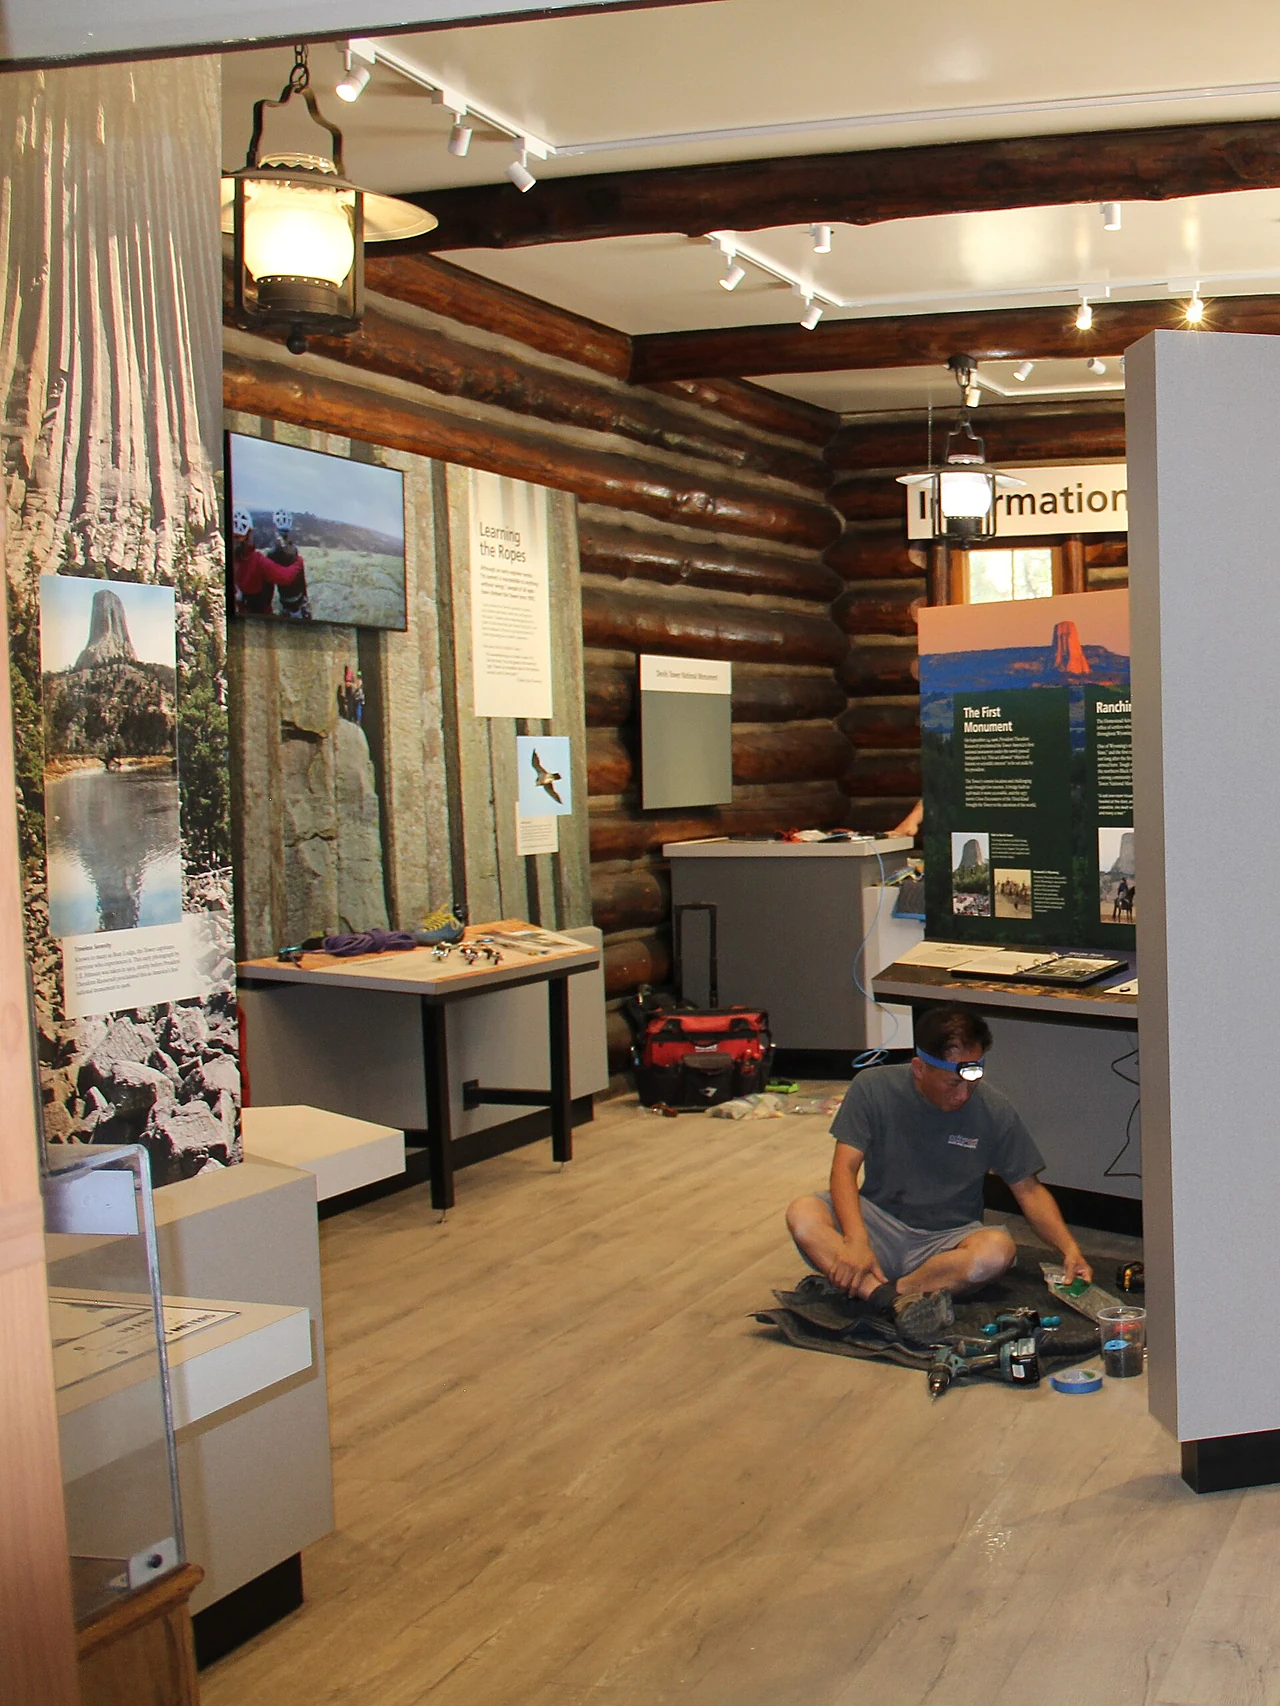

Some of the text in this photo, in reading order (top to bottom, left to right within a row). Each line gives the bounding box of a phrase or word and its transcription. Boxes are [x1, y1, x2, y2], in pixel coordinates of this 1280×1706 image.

[920, 482, 1128, 520] Irmation
[480, 522, 520, 547] Learning
[480, 541, 526, 564] the Ropes
[963, 706, 1001, 718] The First
[964, 721, 1013, 733] Monument
